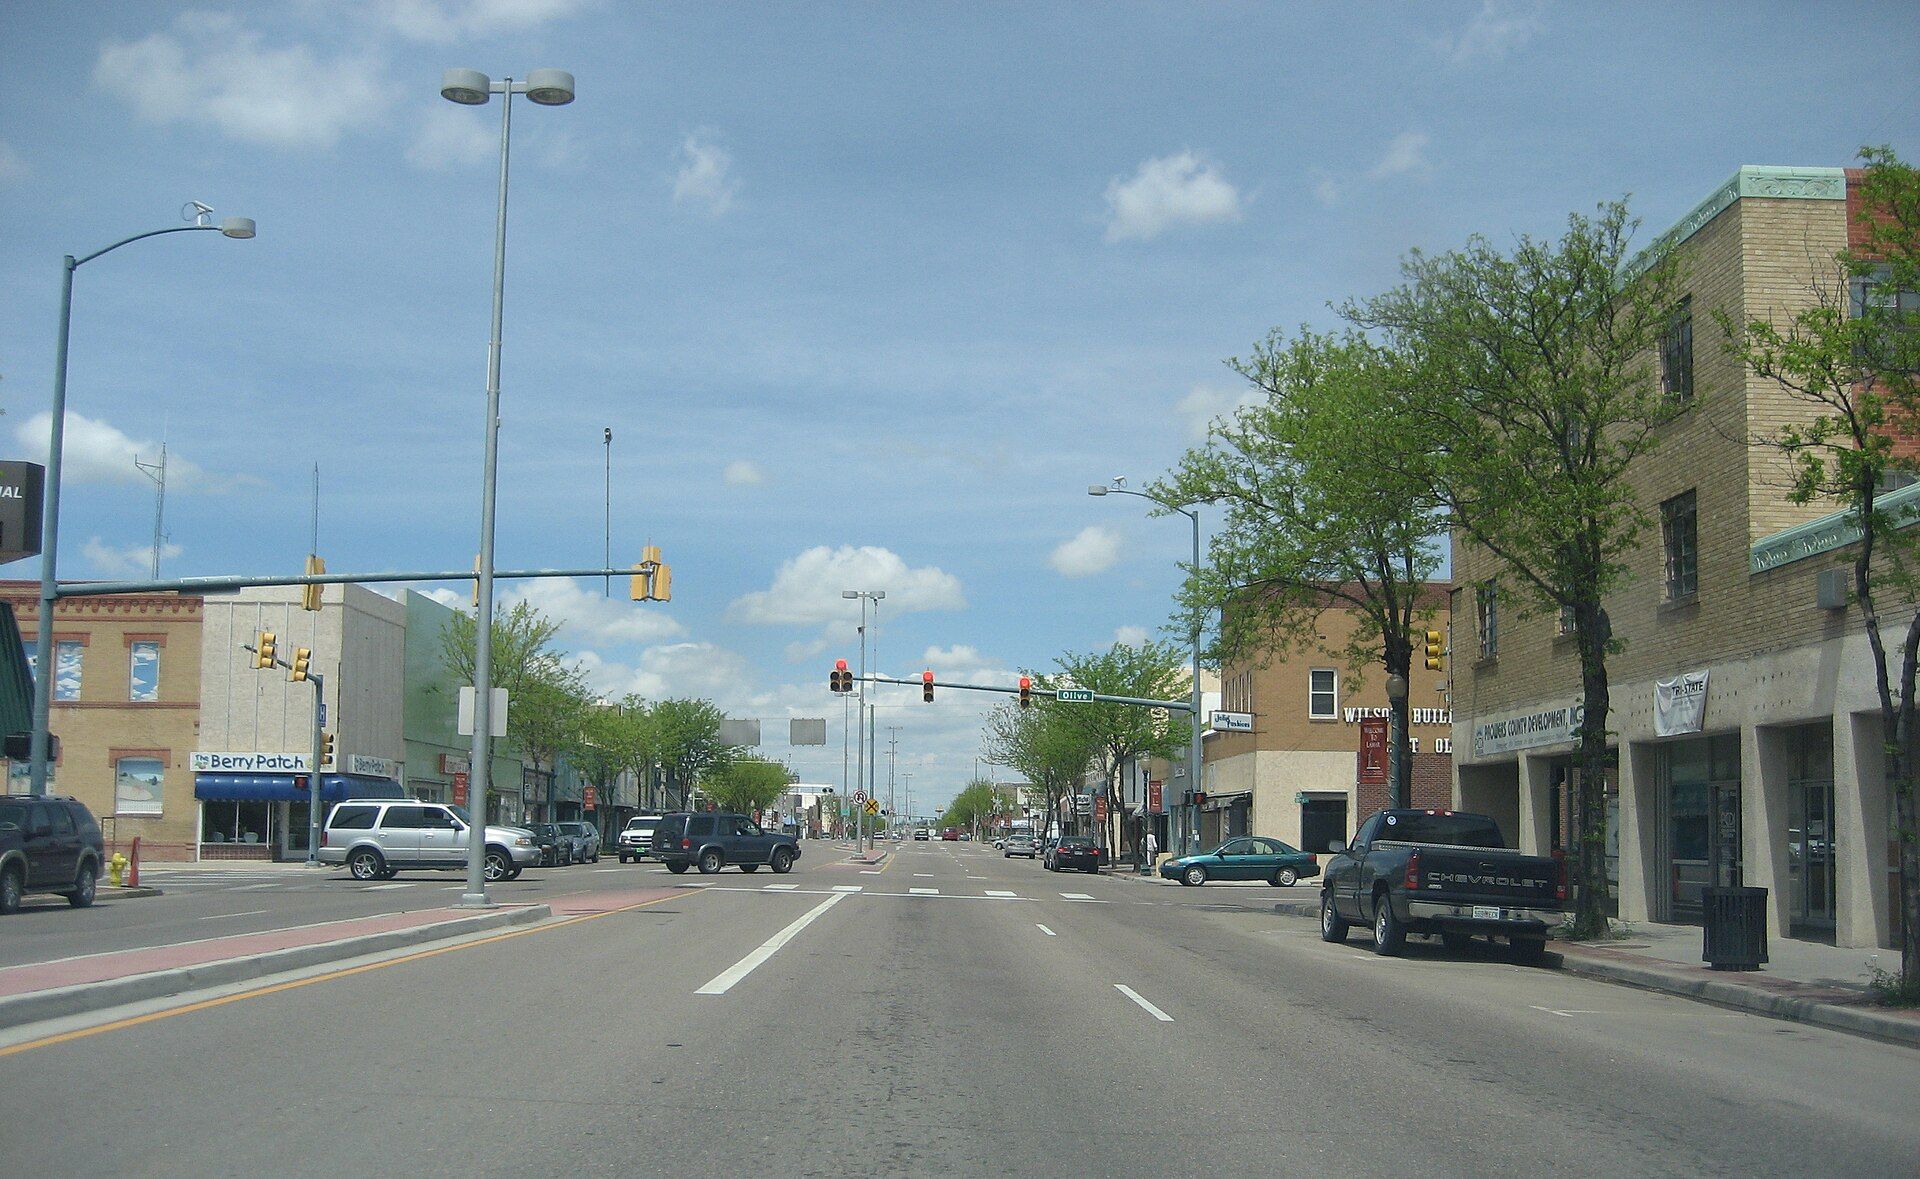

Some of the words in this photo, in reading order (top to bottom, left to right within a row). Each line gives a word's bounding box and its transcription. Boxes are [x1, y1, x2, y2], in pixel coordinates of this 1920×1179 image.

[1062, 691, 1088, 700] Olive
[1508, 716, 1527, 737] COUNTY
[210, 754, 254, 770] Berry
[256, 754, 304, 769] Patch
[1427, 872, 1548, 888] CHEVROLET
